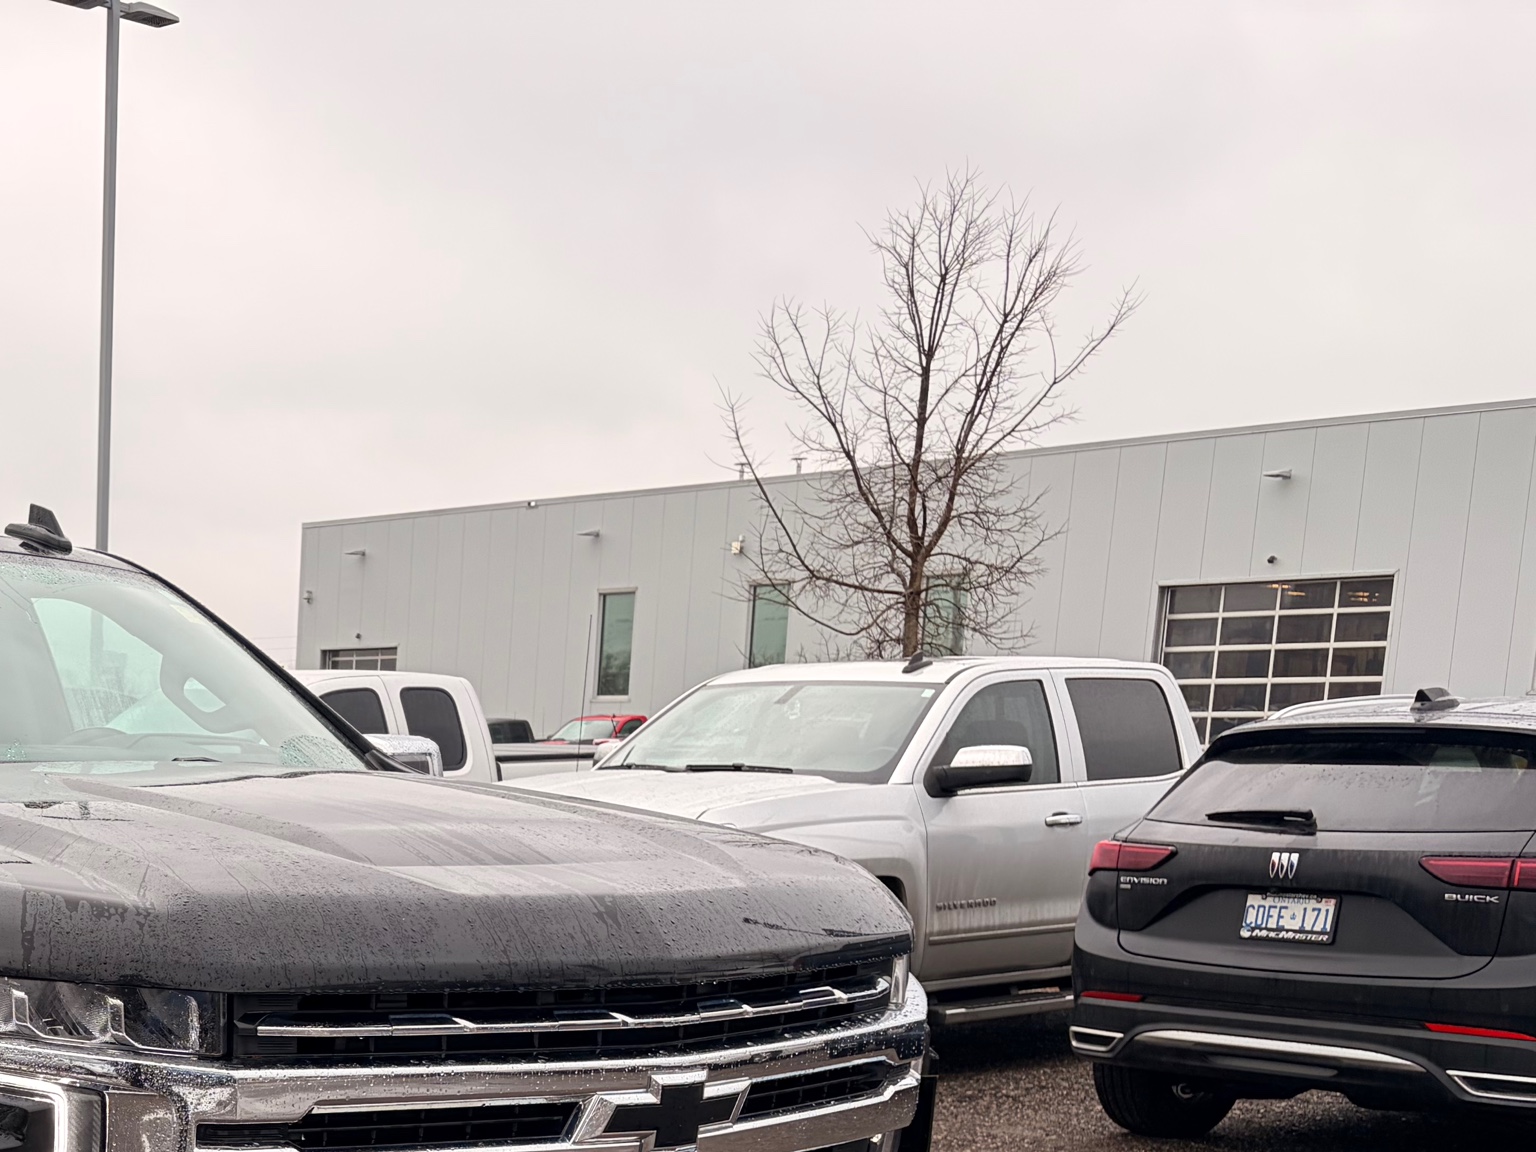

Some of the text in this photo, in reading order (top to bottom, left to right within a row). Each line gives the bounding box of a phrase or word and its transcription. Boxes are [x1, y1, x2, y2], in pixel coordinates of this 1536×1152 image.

[1120, 876, 1168, 885] ENVISION
[1444, 893, 1500, 903] BUICK
[936, 898, 997, 912] SILVERADO
[1299, 907, 1330, 932] 171
